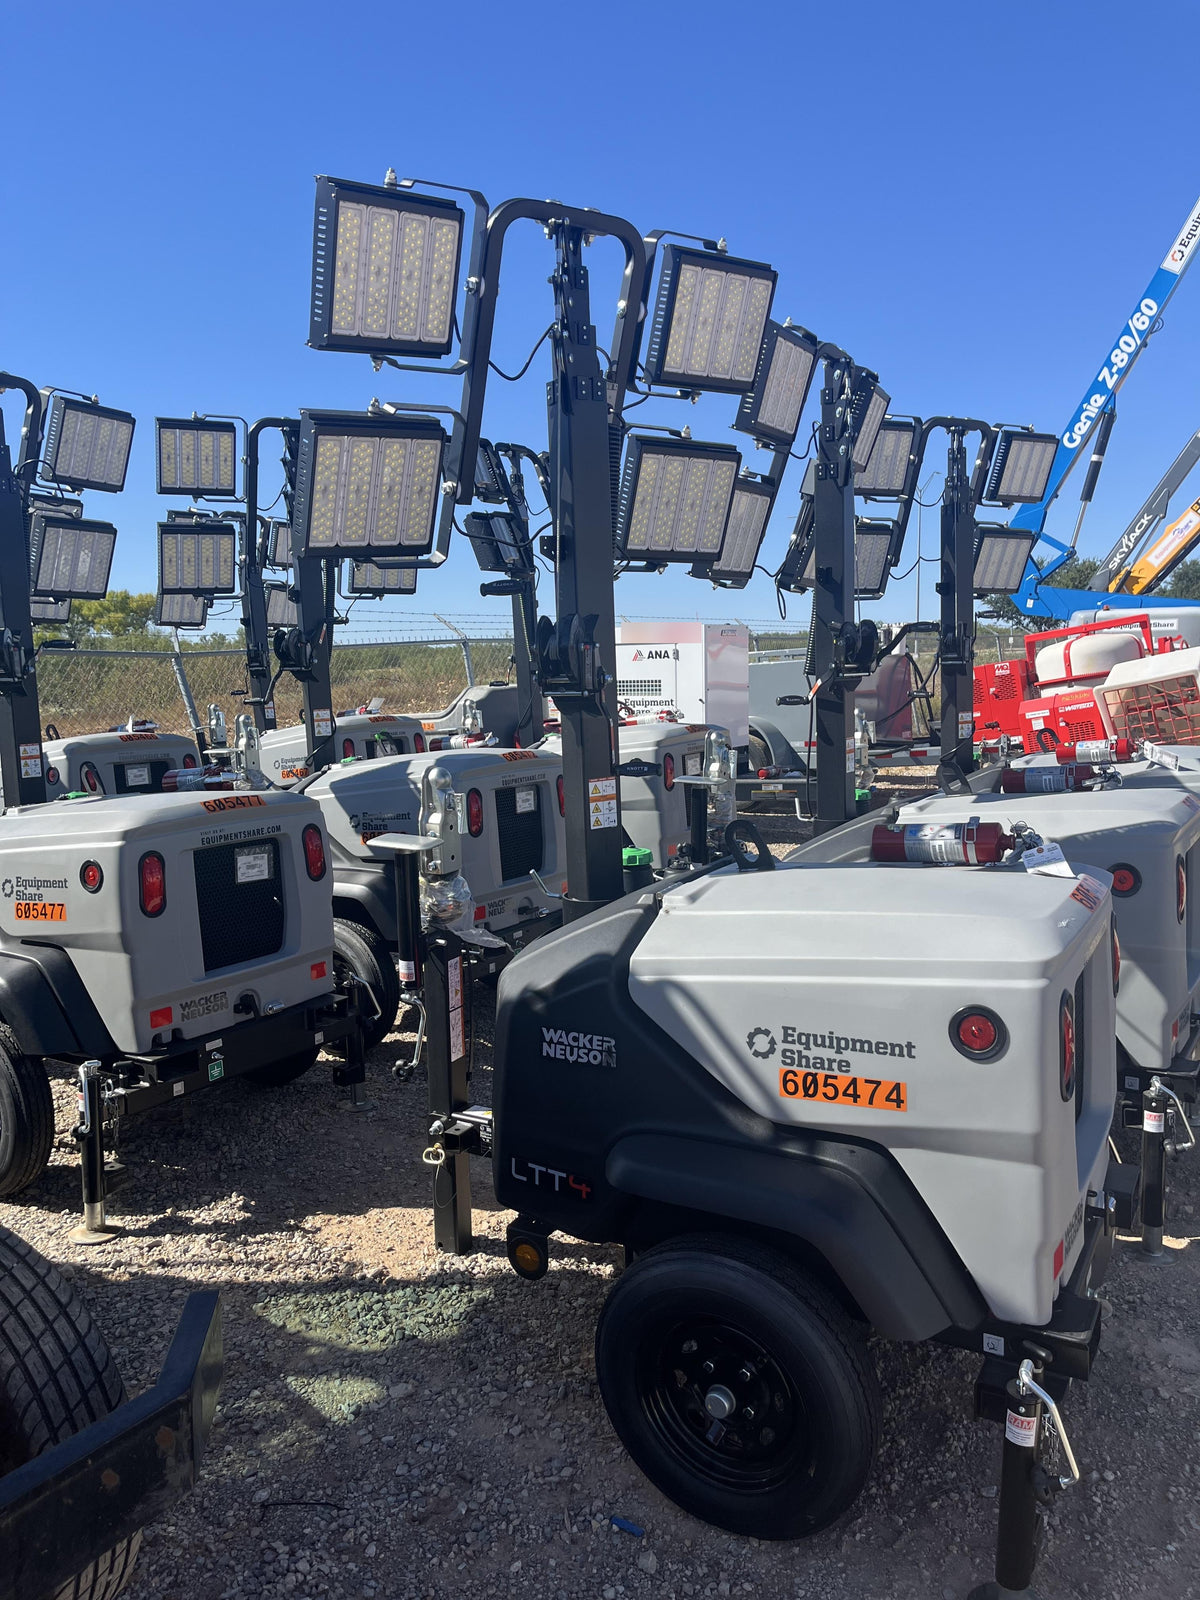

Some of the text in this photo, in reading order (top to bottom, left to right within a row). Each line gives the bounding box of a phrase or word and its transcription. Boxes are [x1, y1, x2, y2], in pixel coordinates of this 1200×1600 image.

[1063, 298, 1158, 449] Genie Z-80/60
[1109, 513, 1153, 570] SKYJACK
[647, 650, 670, 660] ANA
[624, 698, 675, 709] Equipment
[203, 795, 262, 813] 605477
[201, 825, 281, 846] EQUIPMENTSHARE.COM
[362, 822, 388, 831] Share
[16, 876, 68, 890] Equipment
[15, 890, 43, 901] Share
[16, 903, 64, 919] 605477
[180, 991, 227, 1012] WACKER
[181, 1000, 228, 1022] NEUSON
[541, 1027, 616, 1052] WACKER
[781, 1026, 916, 1059] Equipment
[542, 1042, 616, 1068] NEUSON
[781, 1048, 851, 1073] Share
[782, 1070, 904, 1108] 605474
[511, 1157, 591, 1199] LTT4
[1008, 1414, 1034, 1430] RAM
